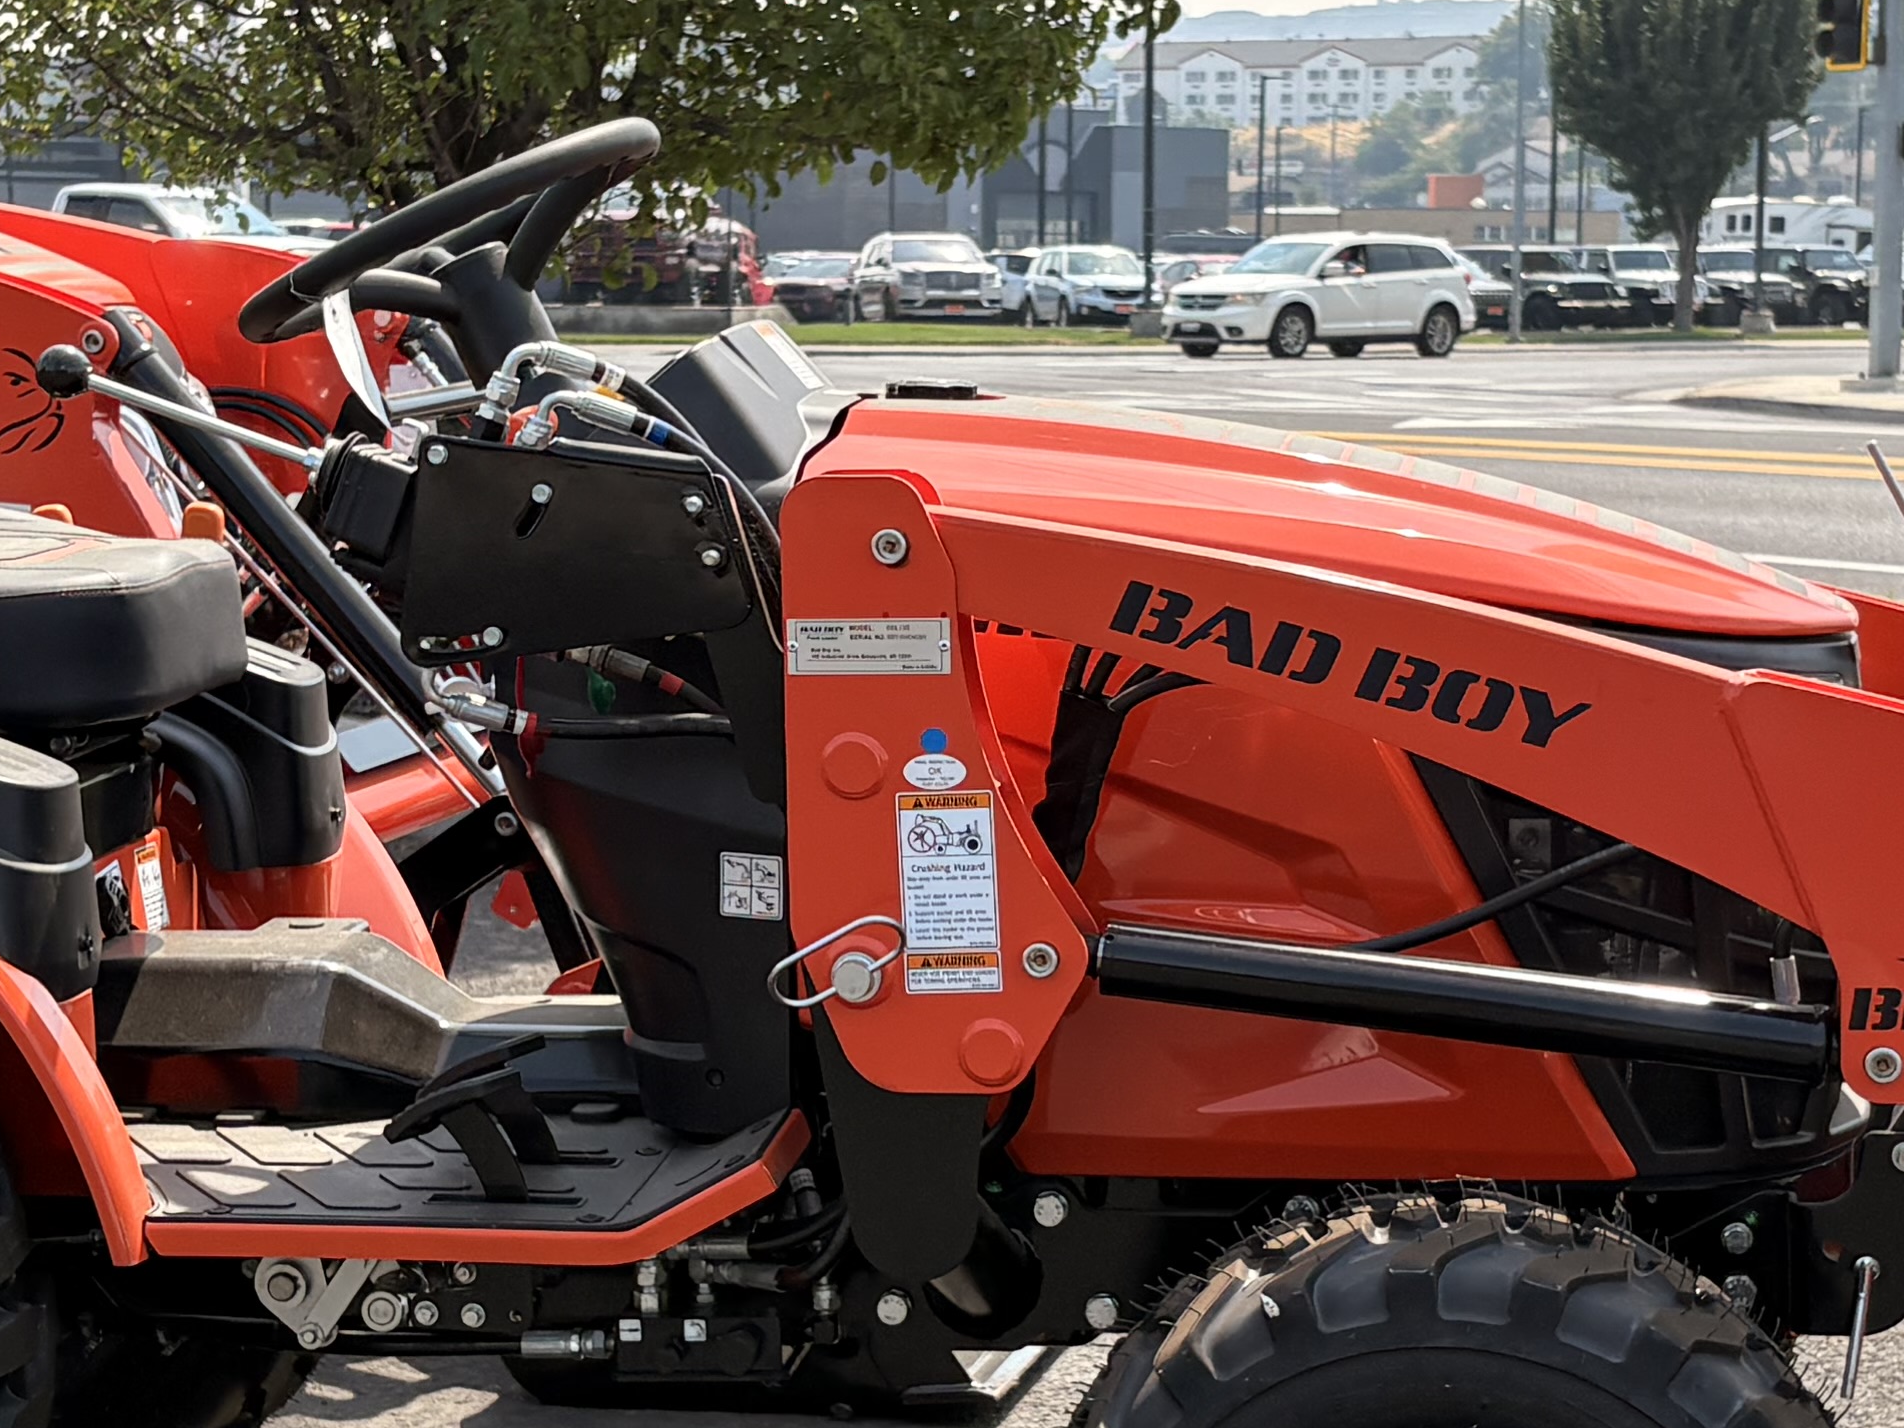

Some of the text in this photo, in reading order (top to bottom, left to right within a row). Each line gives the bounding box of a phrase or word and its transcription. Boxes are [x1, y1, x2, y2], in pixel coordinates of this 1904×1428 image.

[1108, 580, 1591, 748] BAD BOY
[925, 796, 977, 808] WARNING
[911, 862, 985, 874] Crushing Hazard
